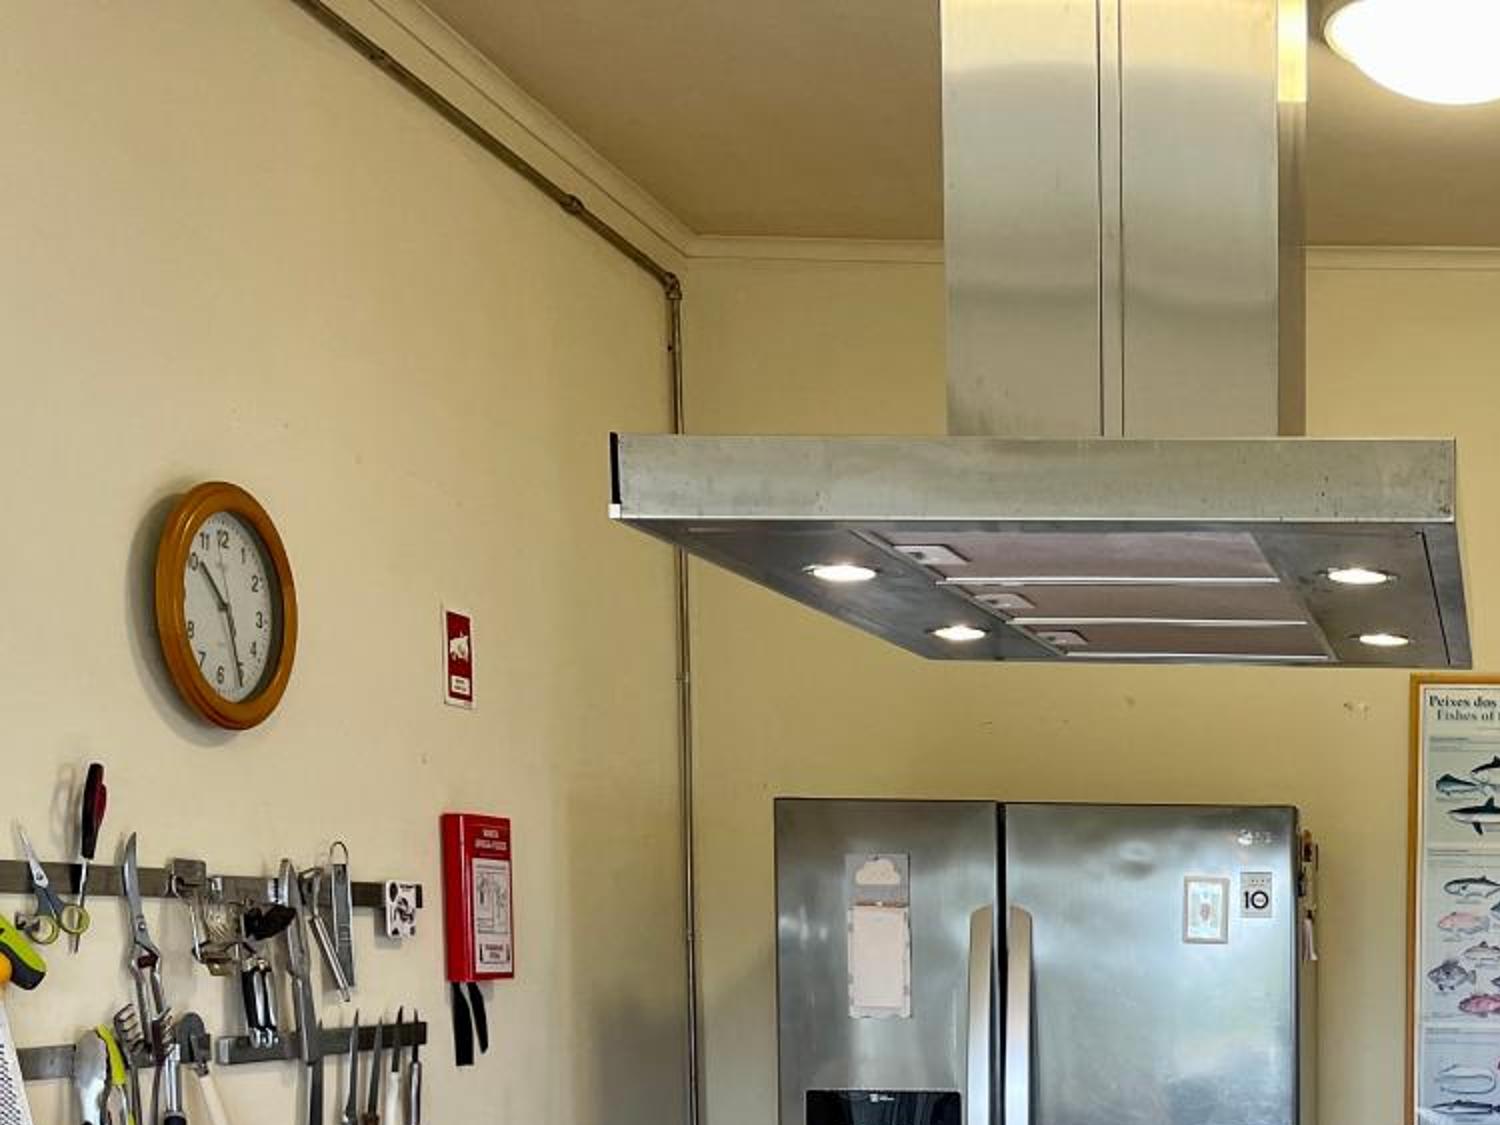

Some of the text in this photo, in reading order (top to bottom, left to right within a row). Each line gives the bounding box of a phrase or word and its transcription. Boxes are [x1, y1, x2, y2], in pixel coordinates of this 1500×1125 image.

[200, 532, 210, 551] 11
[217, 530, 229, 549] 12
[251, 575, 259, 593] 2
[255, 611, 263, 629] 3
[217, 665, 225, 685] 6
[1429, 694, 1471, 707] Peixes
[1473, 695, 1497, 707] dos
[1437, 708, 1477, 721] Fishes
[1481, 709, 1494, 721] of
